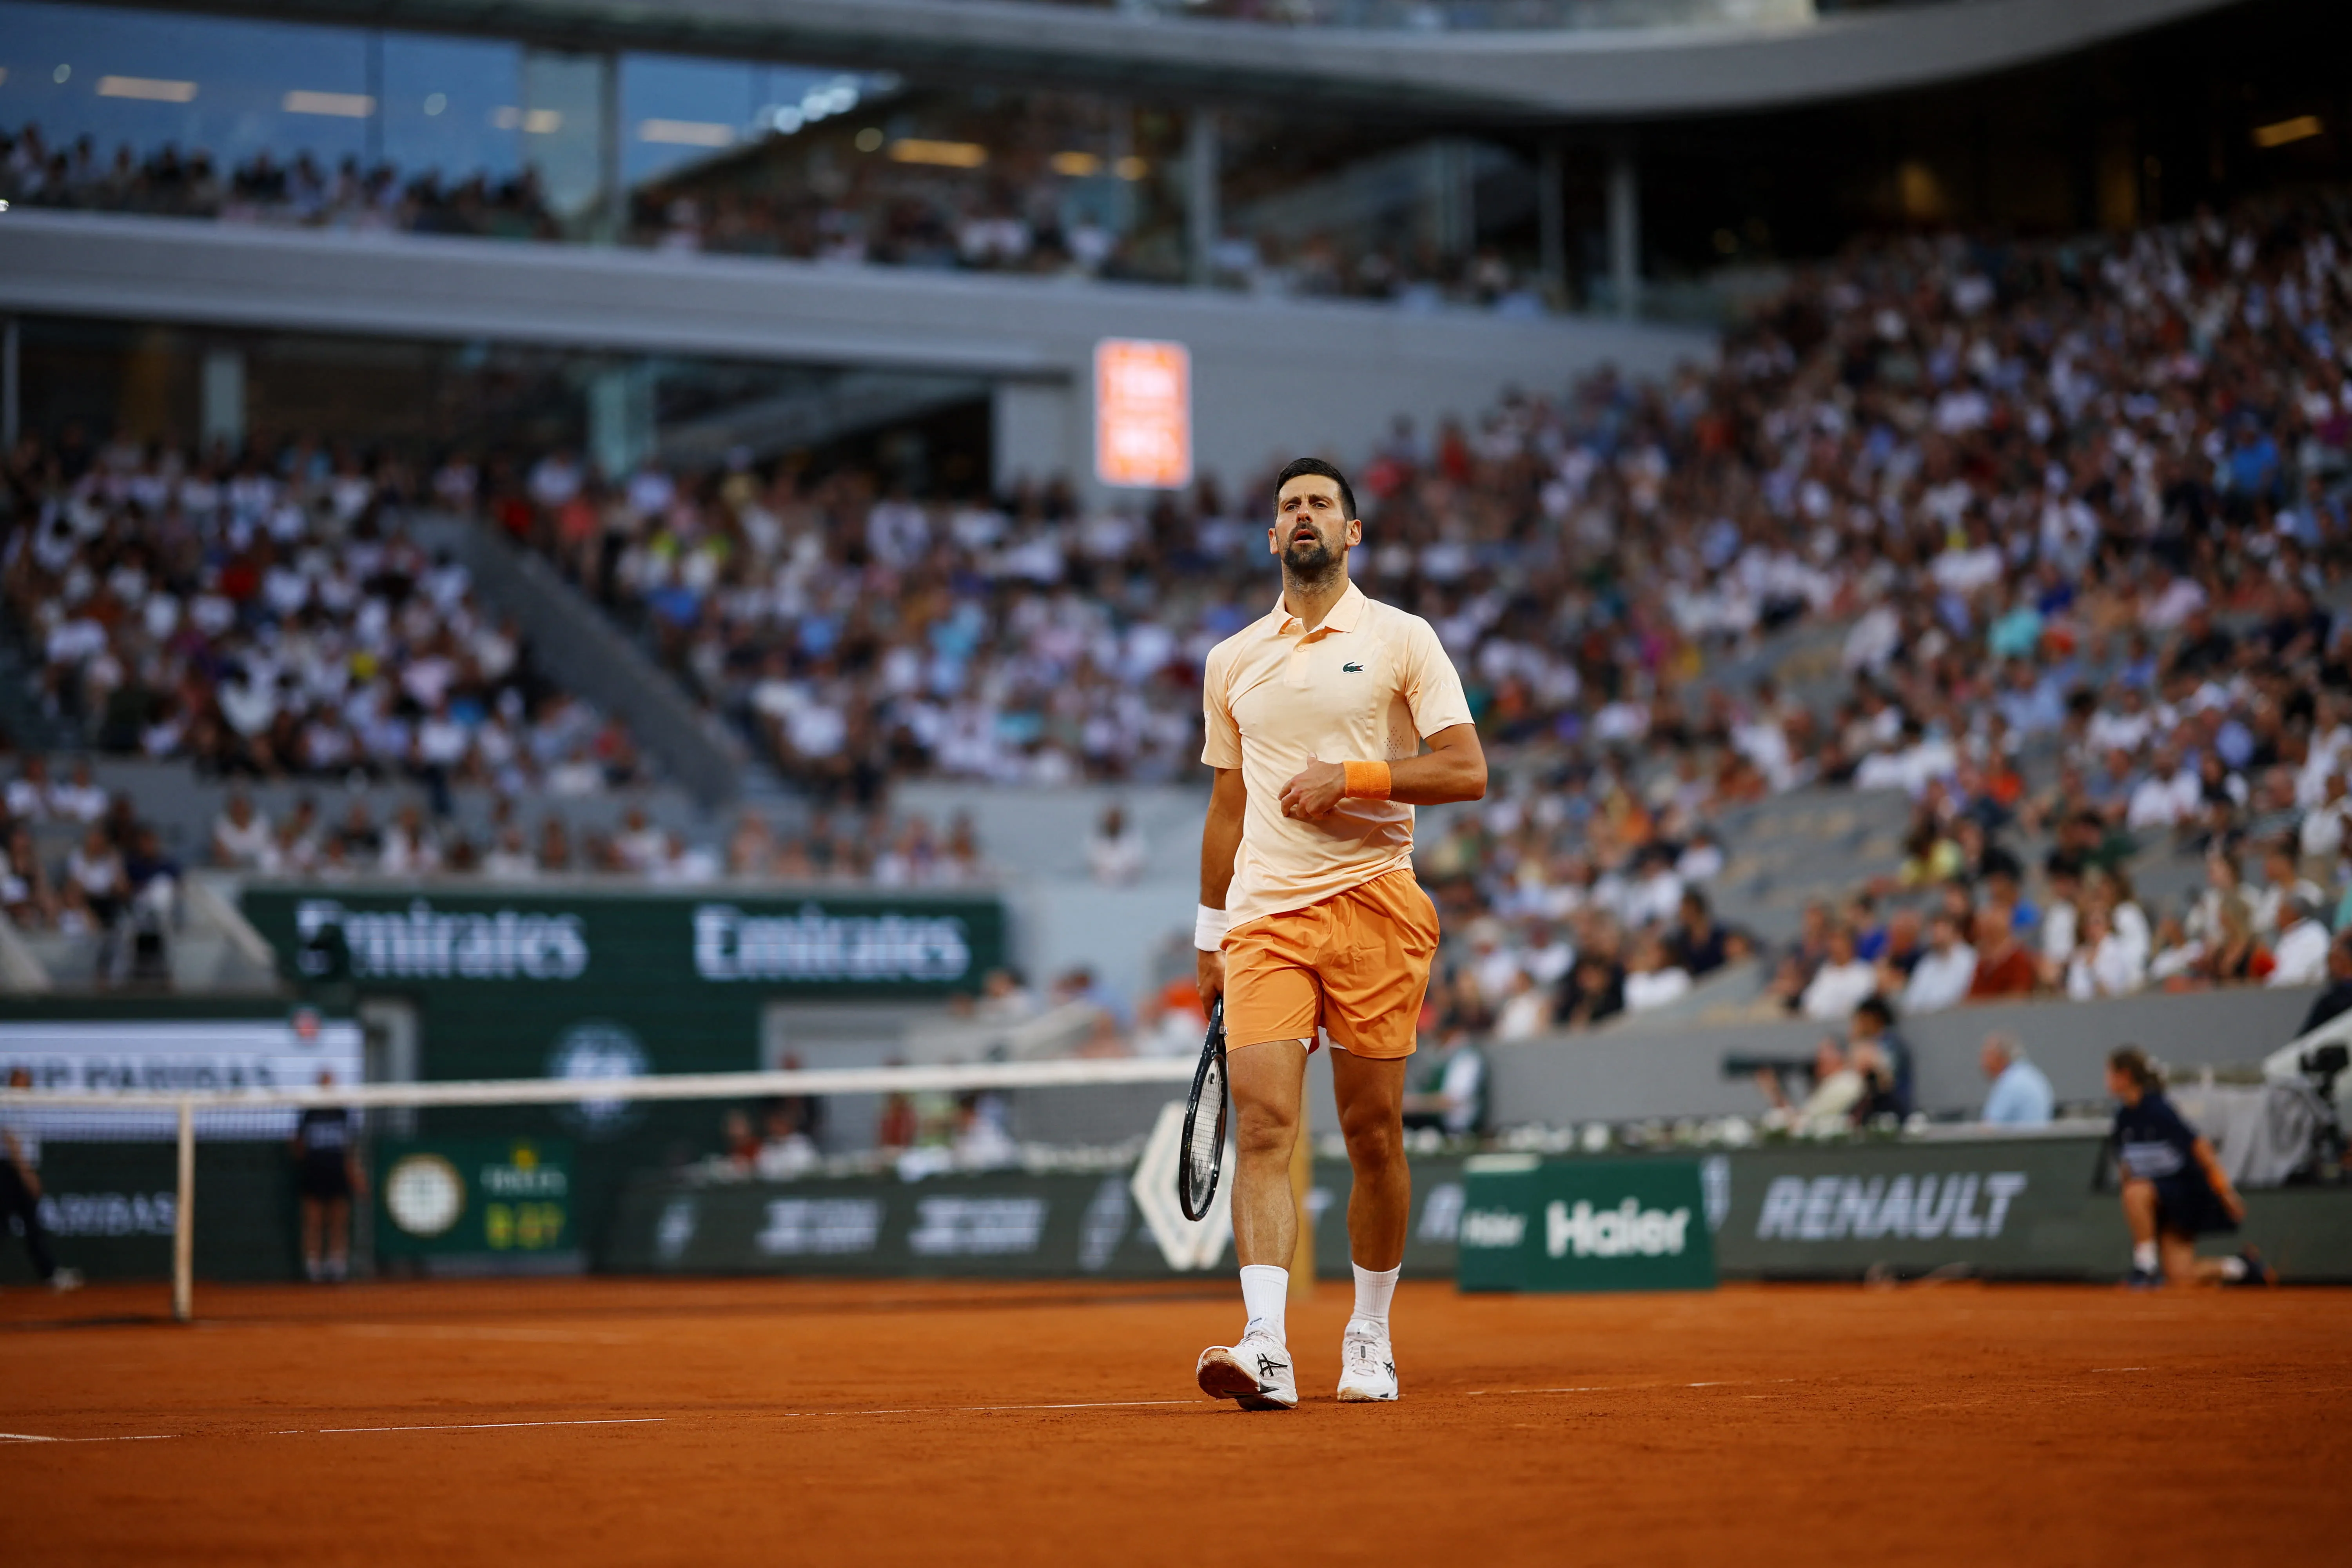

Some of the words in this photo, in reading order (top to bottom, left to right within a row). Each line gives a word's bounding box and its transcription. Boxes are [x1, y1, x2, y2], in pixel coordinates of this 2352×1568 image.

[694, 903, 970, 980] Emirates
[1547, 1196, 1690, 1257] Haier
[1757, 1173, 2027, 1240] RENAULT
